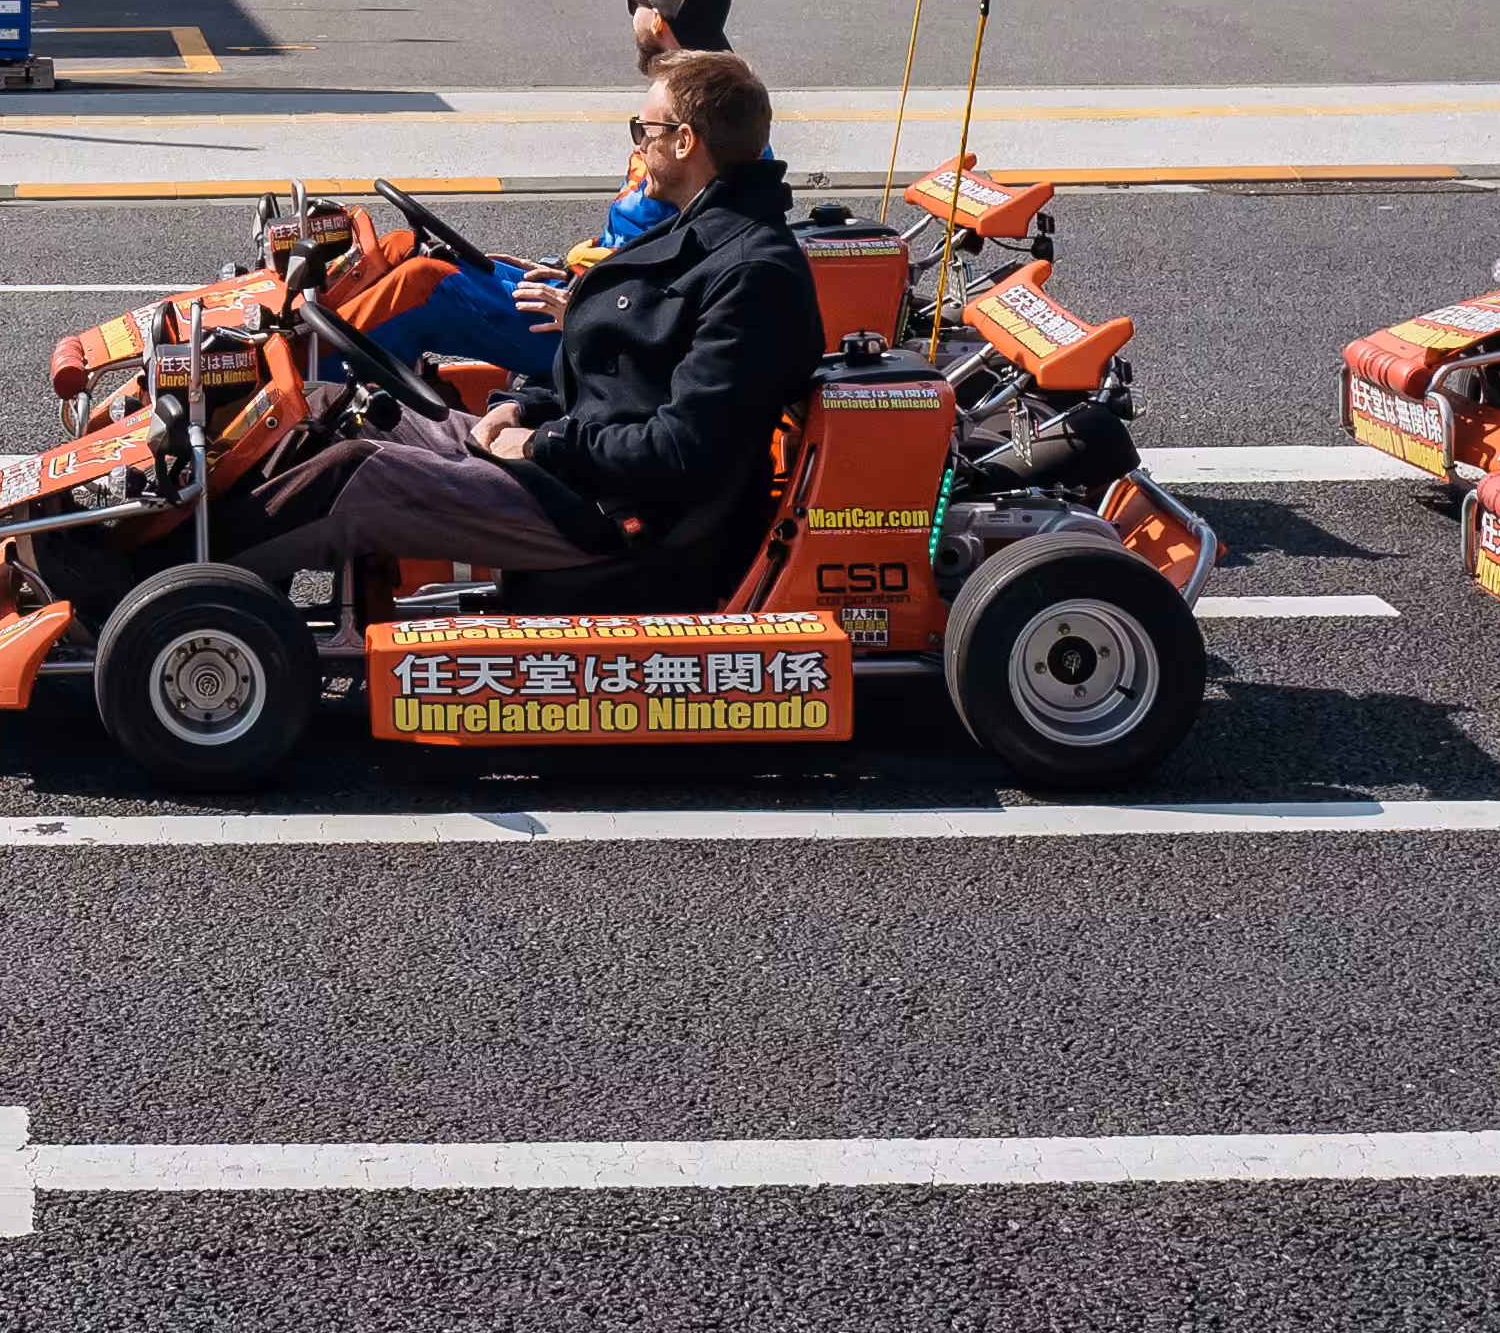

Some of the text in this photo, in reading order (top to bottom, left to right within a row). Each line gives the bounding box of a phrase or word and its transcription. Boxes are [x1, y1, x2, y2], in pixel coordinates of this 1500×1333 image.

[807, 506, 931, 529] MariCar.com
[816, 592, 911, 606] corporation
[394, 651, 828, 696] 任天堂は無関係
[393, 696, 828, 733] Unrelated to Nintendo
